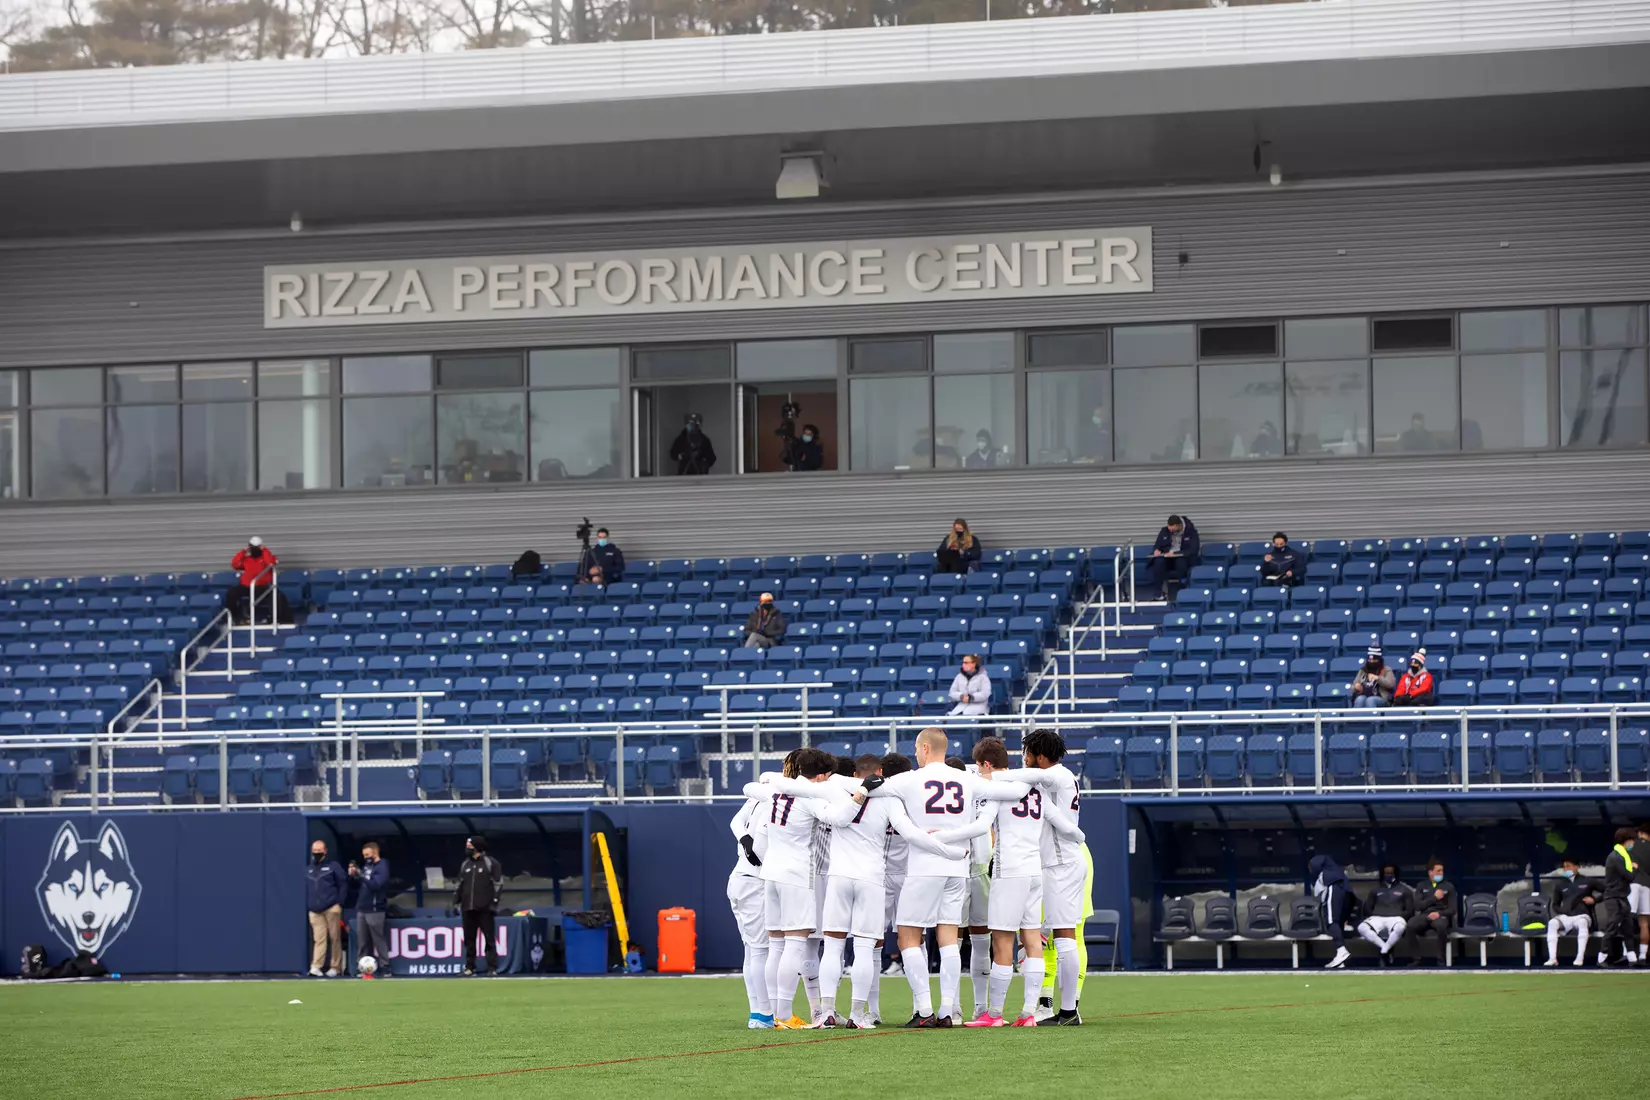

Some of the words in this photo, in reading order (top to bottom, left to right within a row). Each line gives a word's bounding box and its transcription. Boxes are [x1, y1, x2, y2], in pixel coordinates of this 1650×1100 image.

[270, 268, 433, 318] RIZZA
[452, 248, 886, 311] PERFORMANCE
[905, 237, 1142, 293] CENTER
[771, 793, 795, 827] 17
[924, 780, 965, 815] 23
[1011, 786, 1042, 820] 33
[409, 963, 468, 974] HUSKIE
